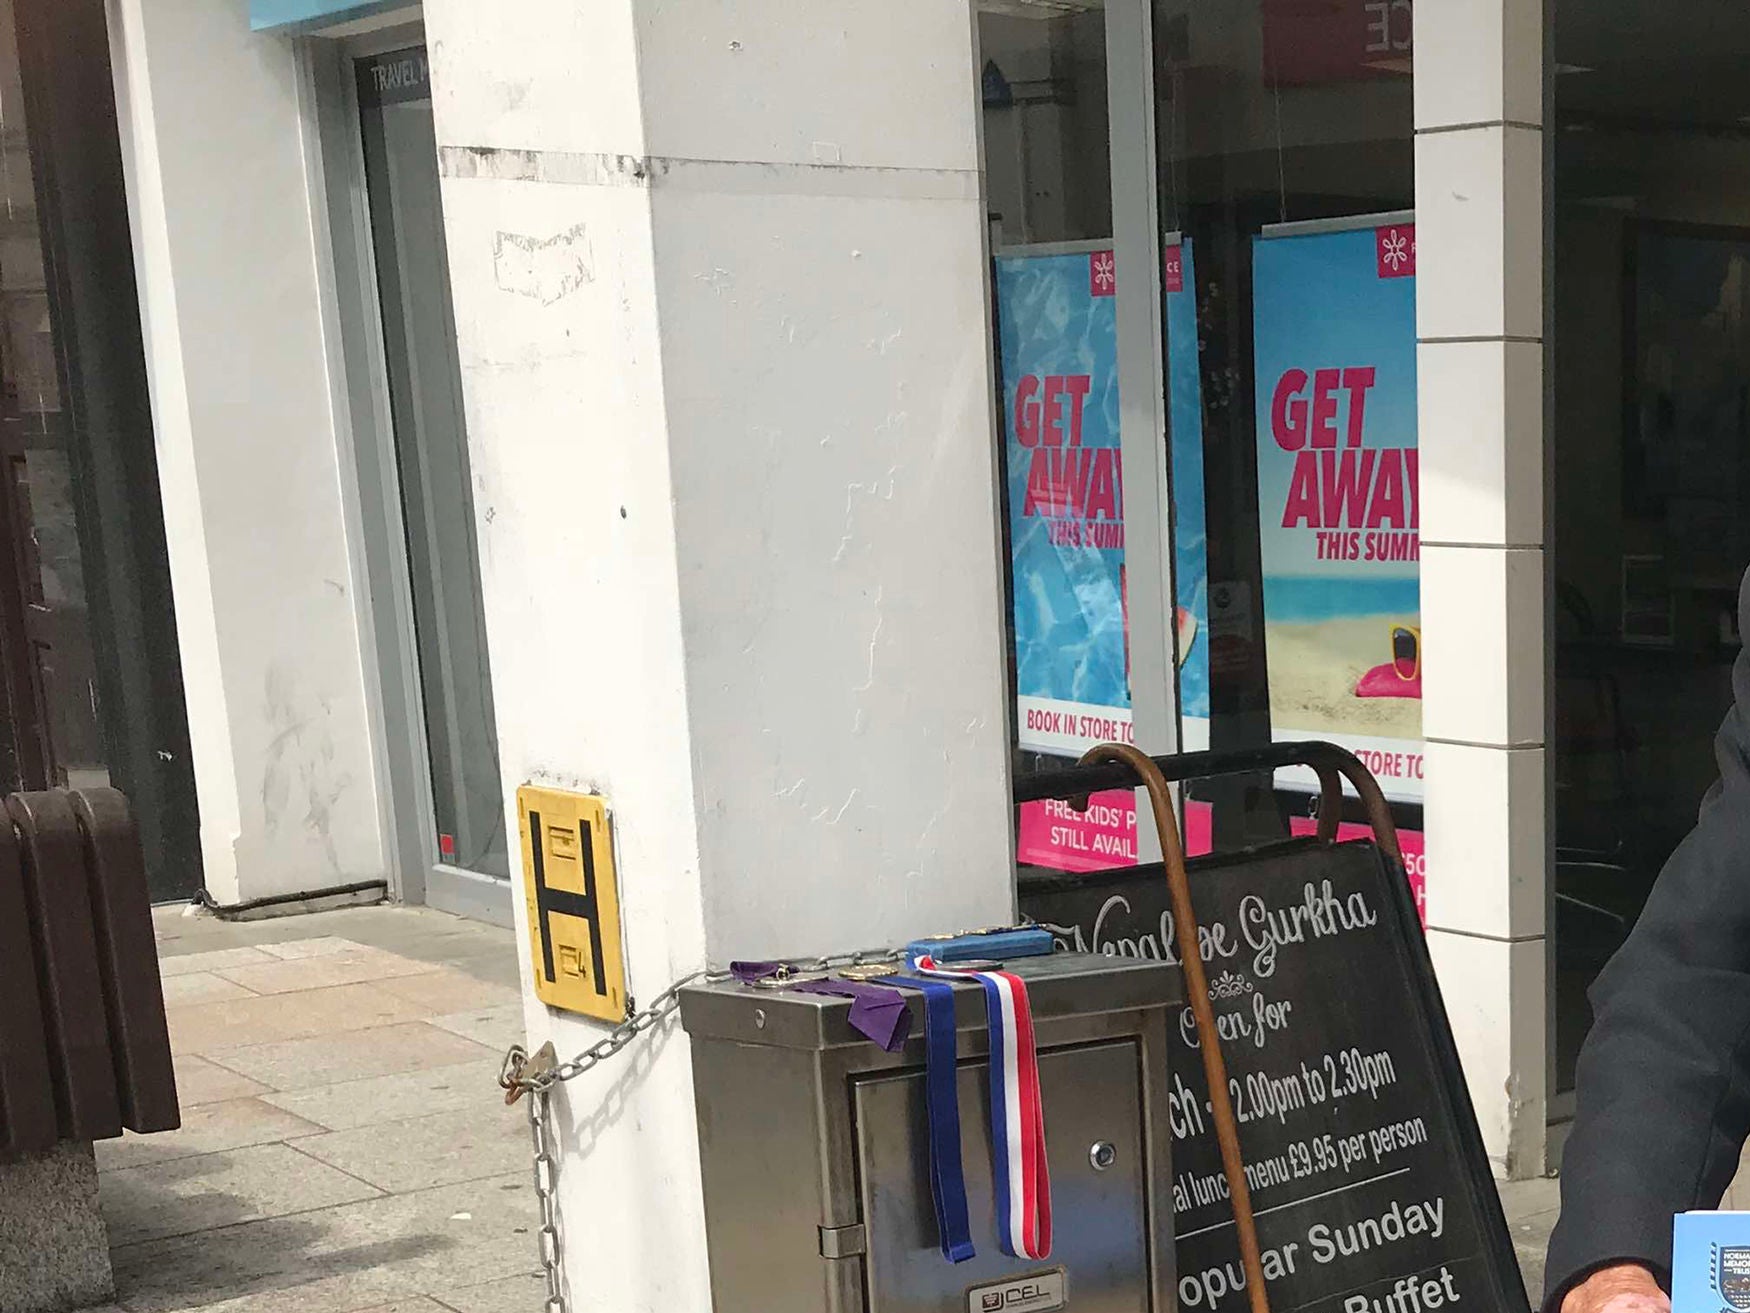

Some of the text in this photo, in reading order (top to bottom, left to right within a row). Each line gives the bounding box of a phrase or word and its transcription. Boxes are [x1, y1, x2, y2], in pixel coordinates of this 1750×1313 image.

[1014, 374, 1090, 448] GET
[1271, 367, 1376, 451] GET
[1023, 448, 1124, 519] AWA
[1049, 521, 1125, 548] THIS SUM
[1316, 531, 1360, 560] THIS
[1027, 709, 1060, 733] BOOK
[1064, 714, 1077, 735] IN
[1080, 716, 1117, 741] STORE
[1051, 826, 1136, 859] STILL AVAIL
[529, 810, 607, 996] H
[1239, 879, 1377, 977] Gurkha
[1179, 992, 1291, 1048] Oen for
[1300, 1061, 1326, 1104] to
[1323, 1047, 1397, 1099] 2.30pm
[1188, 1171, 1231, 1208] lunc
[1243, 1156, 1290, 1191] menu
[1288, 1134, 1337, 1179] £9.95
[1338, 1132, 1365, 1173] per
[1371, 1116, 1427, 1164] person
[1307, 1197, 1444, 1263] Sunday
